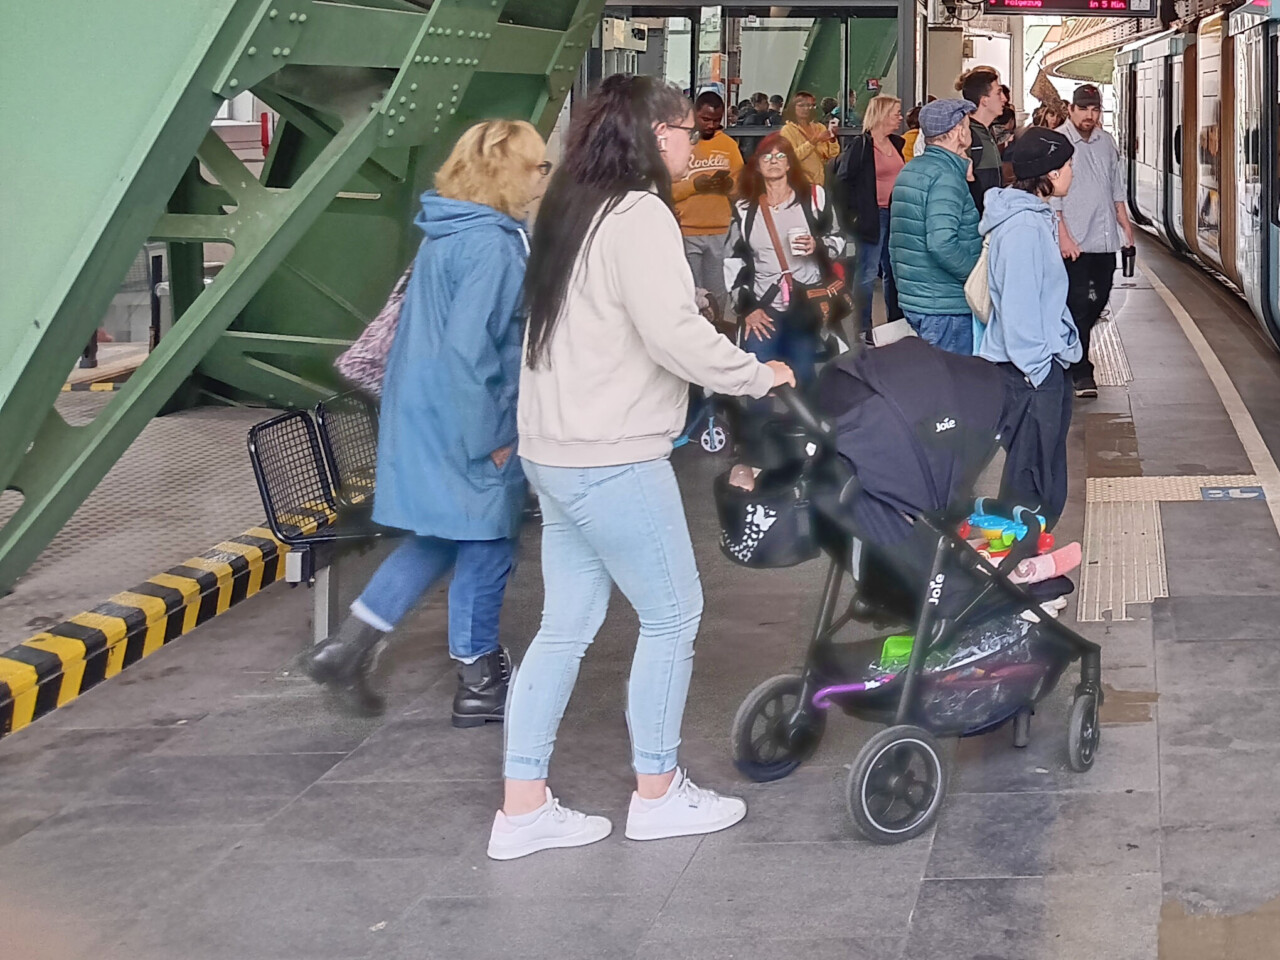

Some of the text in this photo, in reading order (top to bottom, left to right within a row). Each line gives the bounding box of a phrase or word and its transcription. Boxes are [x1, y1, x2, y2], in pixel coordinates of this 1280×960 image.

[1089, 0, 1099, 8] in
[1101, 0, 1108, 8] 5
[935, 417, 956, 433] Joie
[928, 573, 945, 606] Joie
